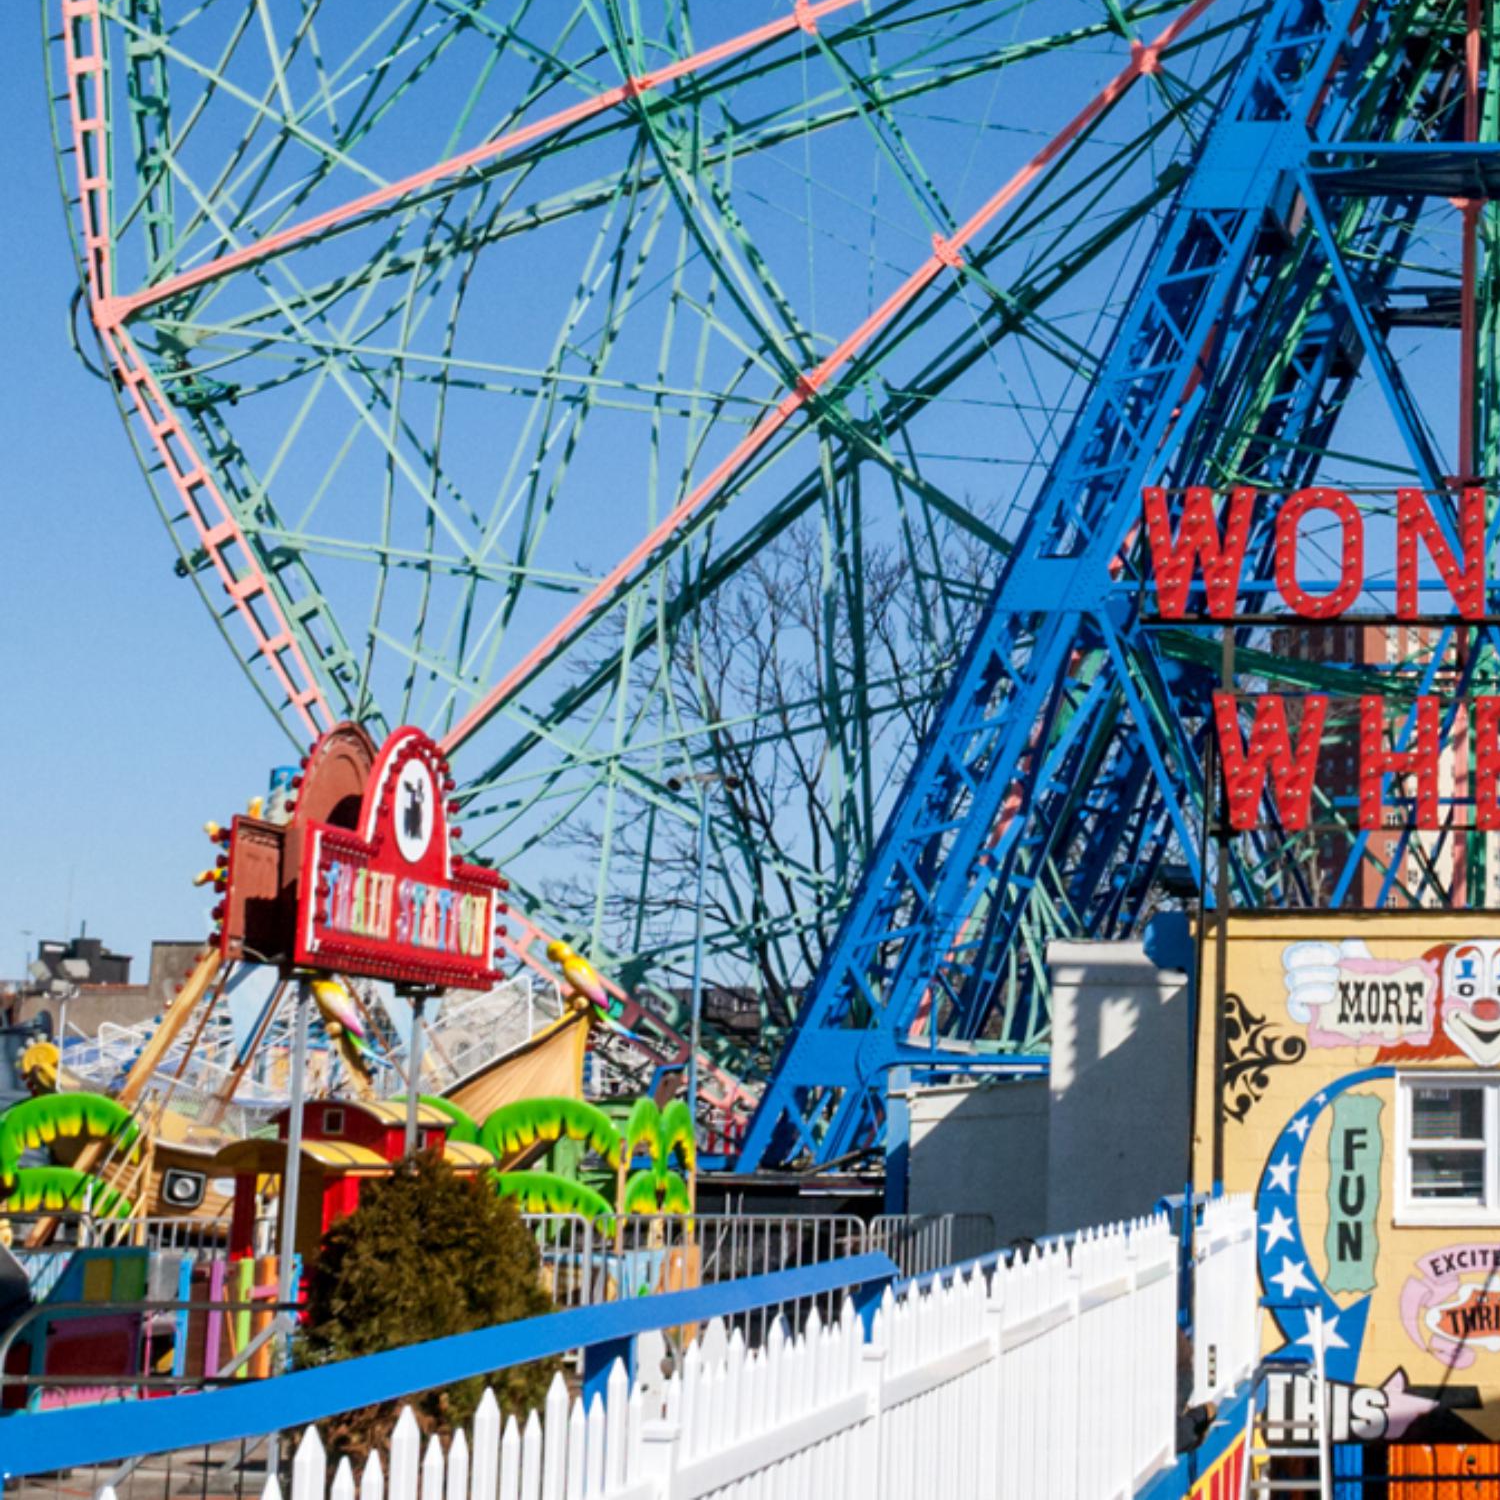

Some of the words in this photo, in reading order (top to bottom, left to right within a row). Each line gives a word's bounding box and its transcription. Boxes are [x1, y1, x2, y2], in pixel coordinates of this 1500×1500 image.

[323, 861, 395, 940] TRAIN
[397, 878, 487, 958] STATION
[1337, 980, 1424, 1025] MORE
[1338, 1128, 1368, 1263] FUN
[1267, 1373, 1386, 1440] THIS
